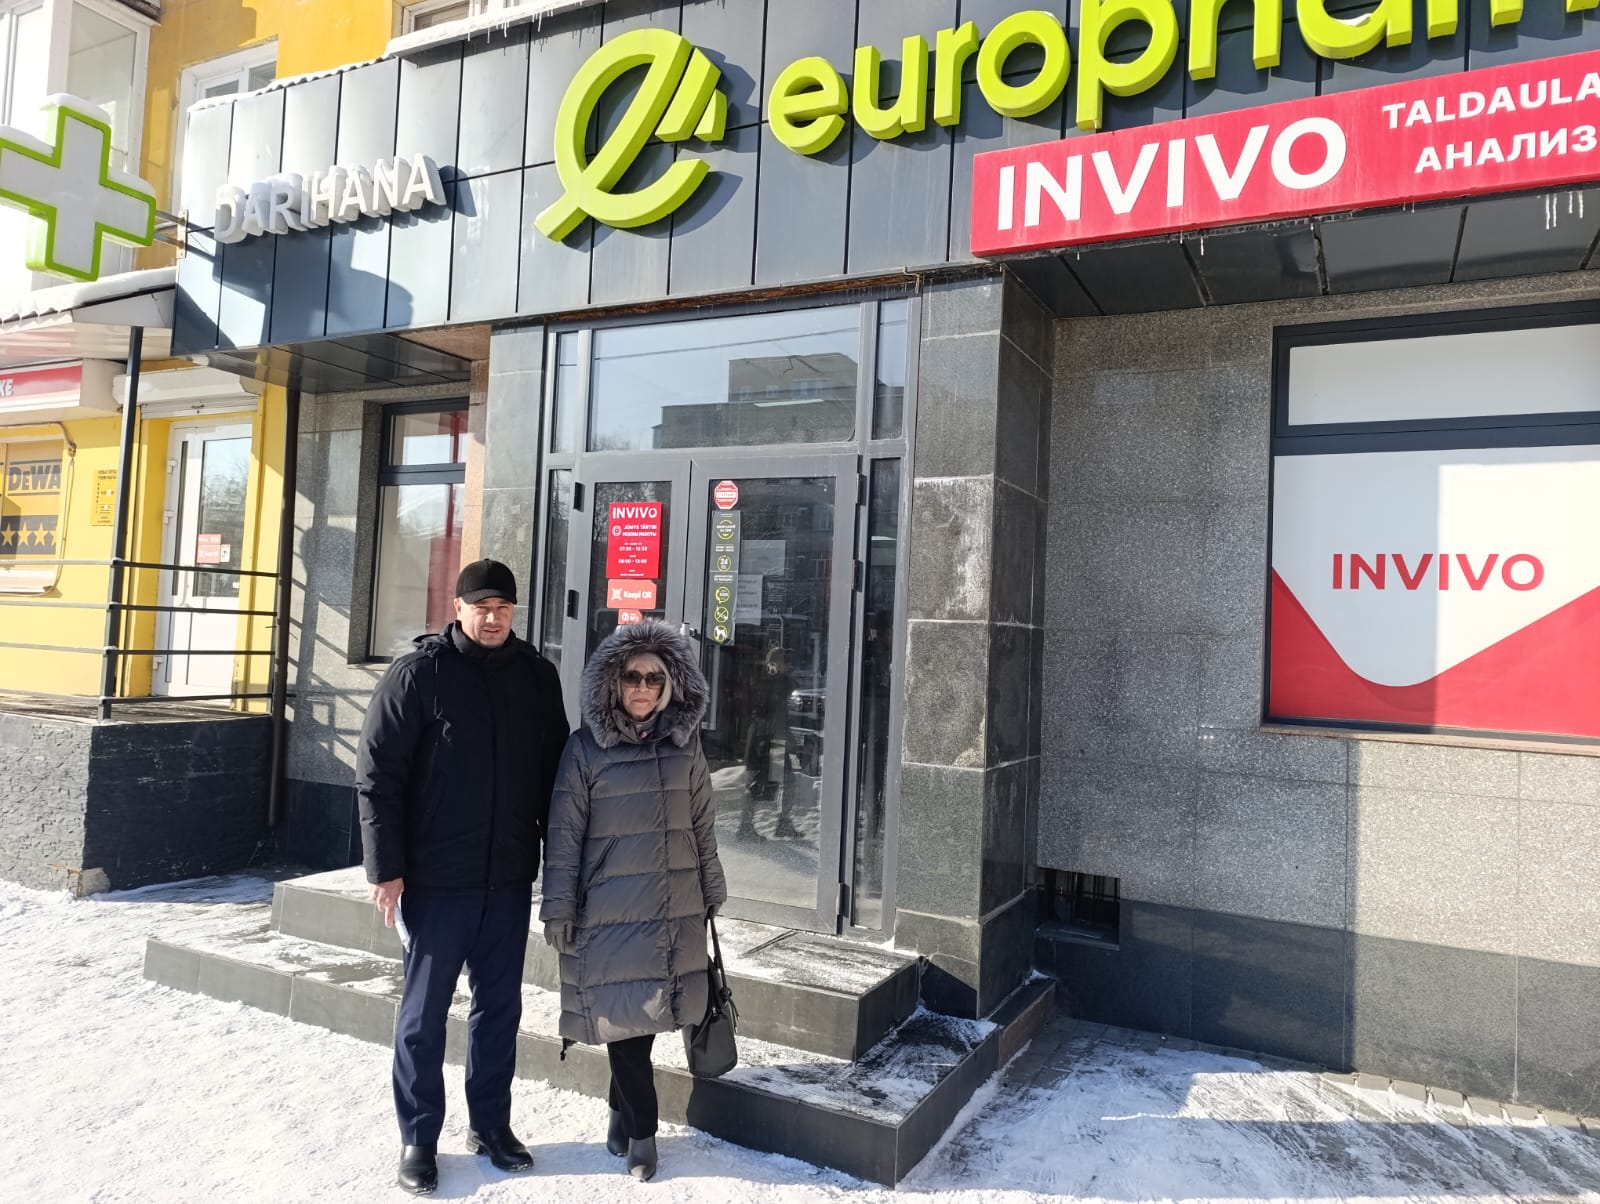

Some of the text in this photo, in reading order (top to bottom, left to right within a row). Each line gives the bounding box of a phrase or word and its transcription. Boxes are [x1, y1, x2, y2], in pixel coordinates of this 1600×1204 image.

[1382, 72, 1600, 129] TALDAULA
[997, 117, 1347, 230] INVIVO
[1414, 125, 1598, 174] АНАЛИЗ
[213, 152, 446, 245] DARIHANA
[612, 507, 658, 519] INVIVO
[1332, 553, 1545, 591] INVIVO
